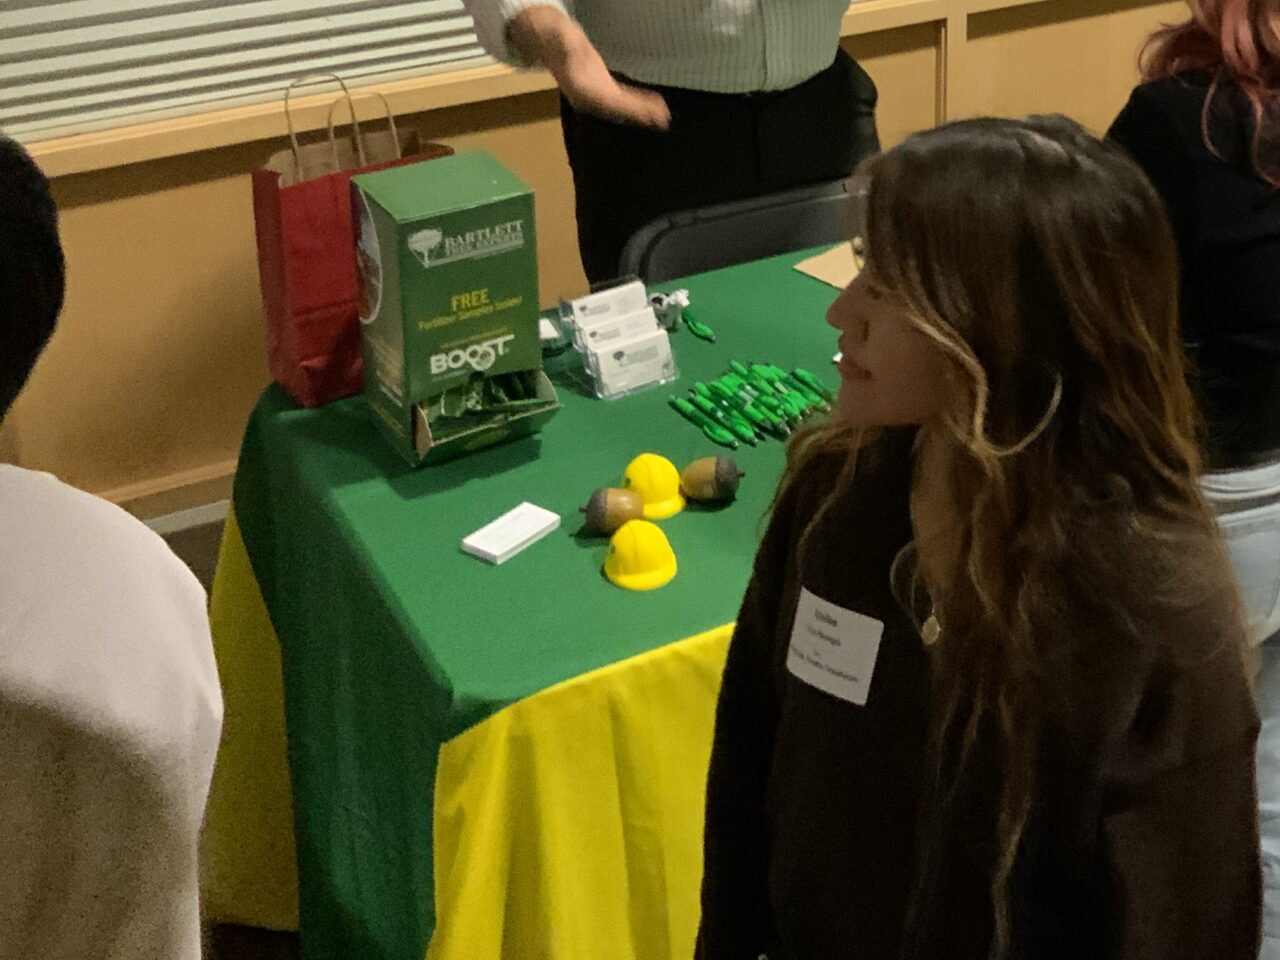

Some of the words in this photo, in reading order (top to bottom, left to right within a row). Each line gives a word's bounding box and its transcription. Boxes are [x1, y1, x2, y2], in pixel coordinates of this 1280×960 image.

[445, 220, 524, 248] BARTLETT
[452, 289, 489, 311] FREE
[430, 334, 515, 375] BOOST
